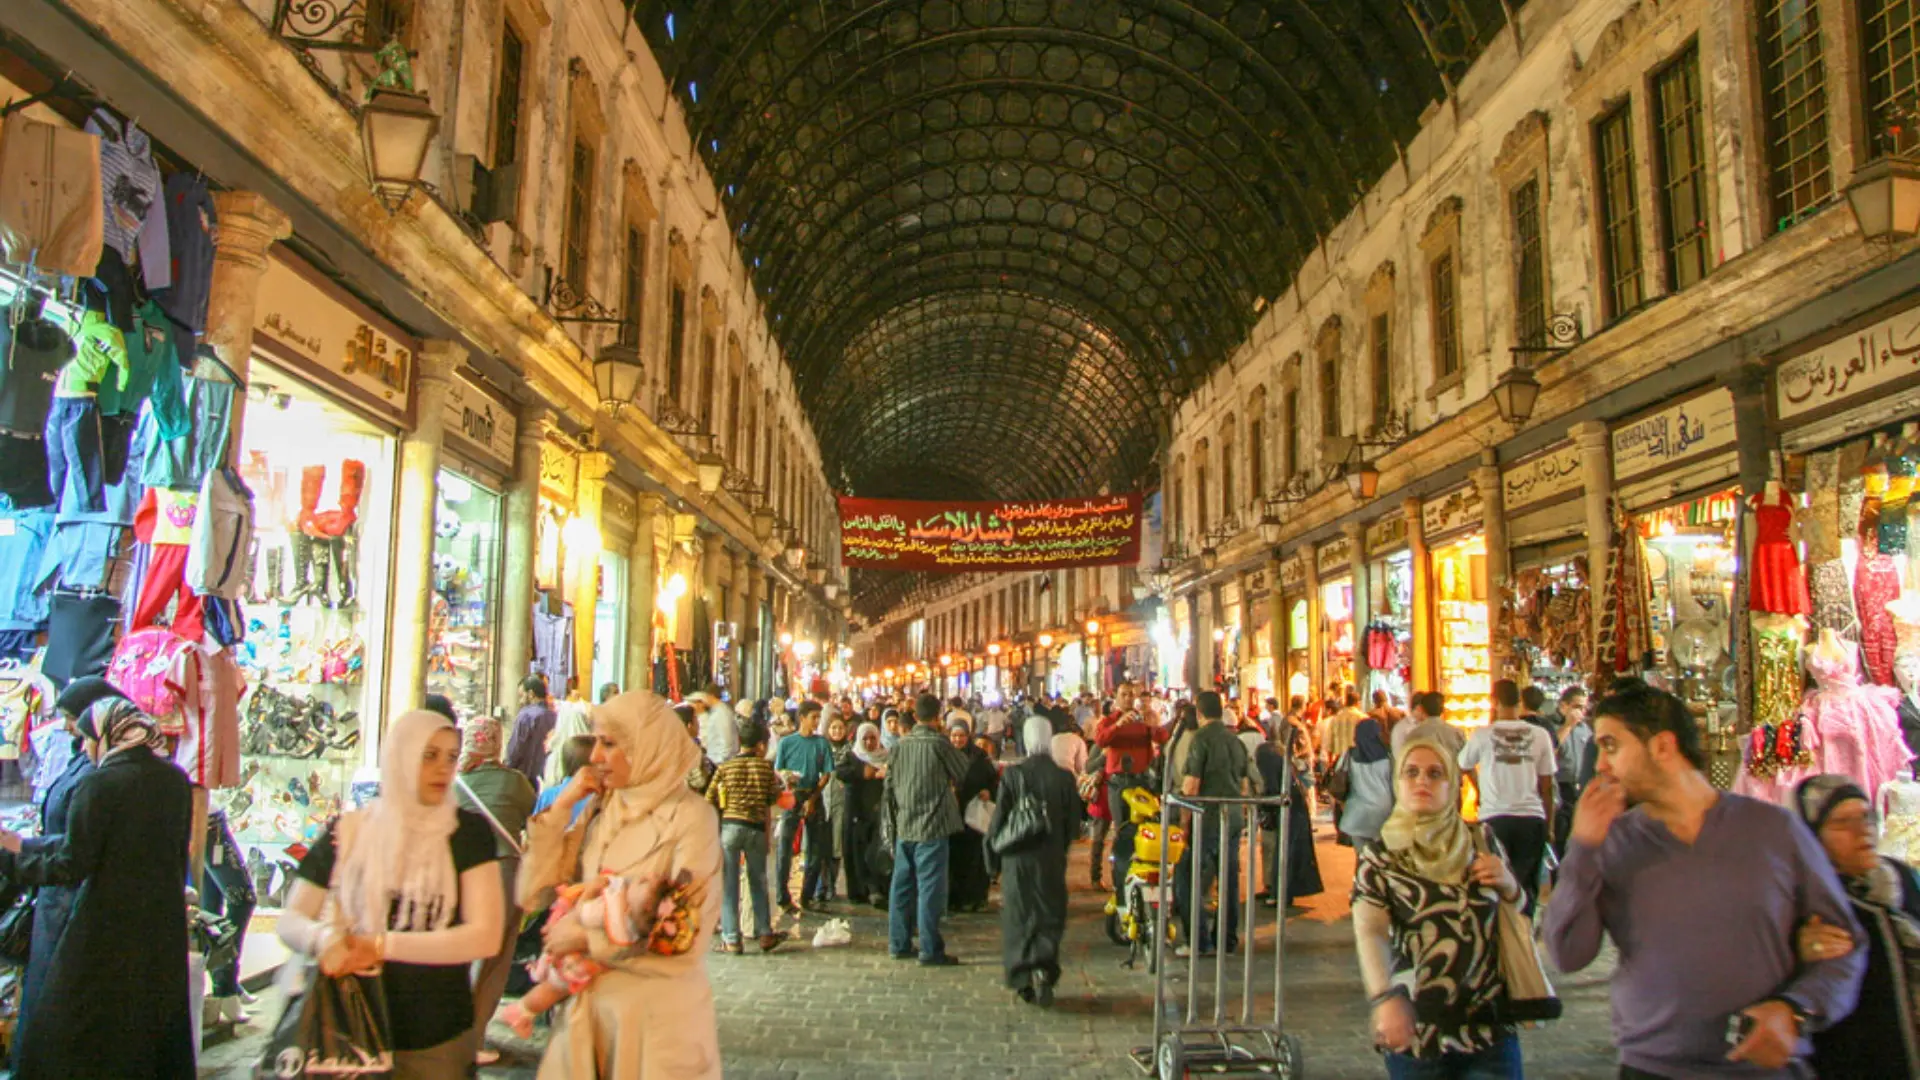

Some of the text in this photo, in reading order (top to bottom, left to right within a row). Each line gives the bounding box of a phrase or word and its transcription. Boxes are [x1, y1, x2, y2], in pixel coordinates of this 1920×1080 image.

[1785, 332, 1875, 404] العروس
[1507, 461, 1541, 504] الربيع
[1056, 500, 1092, 519] السوري
[1093, 496, 1128, 515] الشعب
[843, 514, 872, 530] الناس
[959, 512, 1014, 546] بشار
